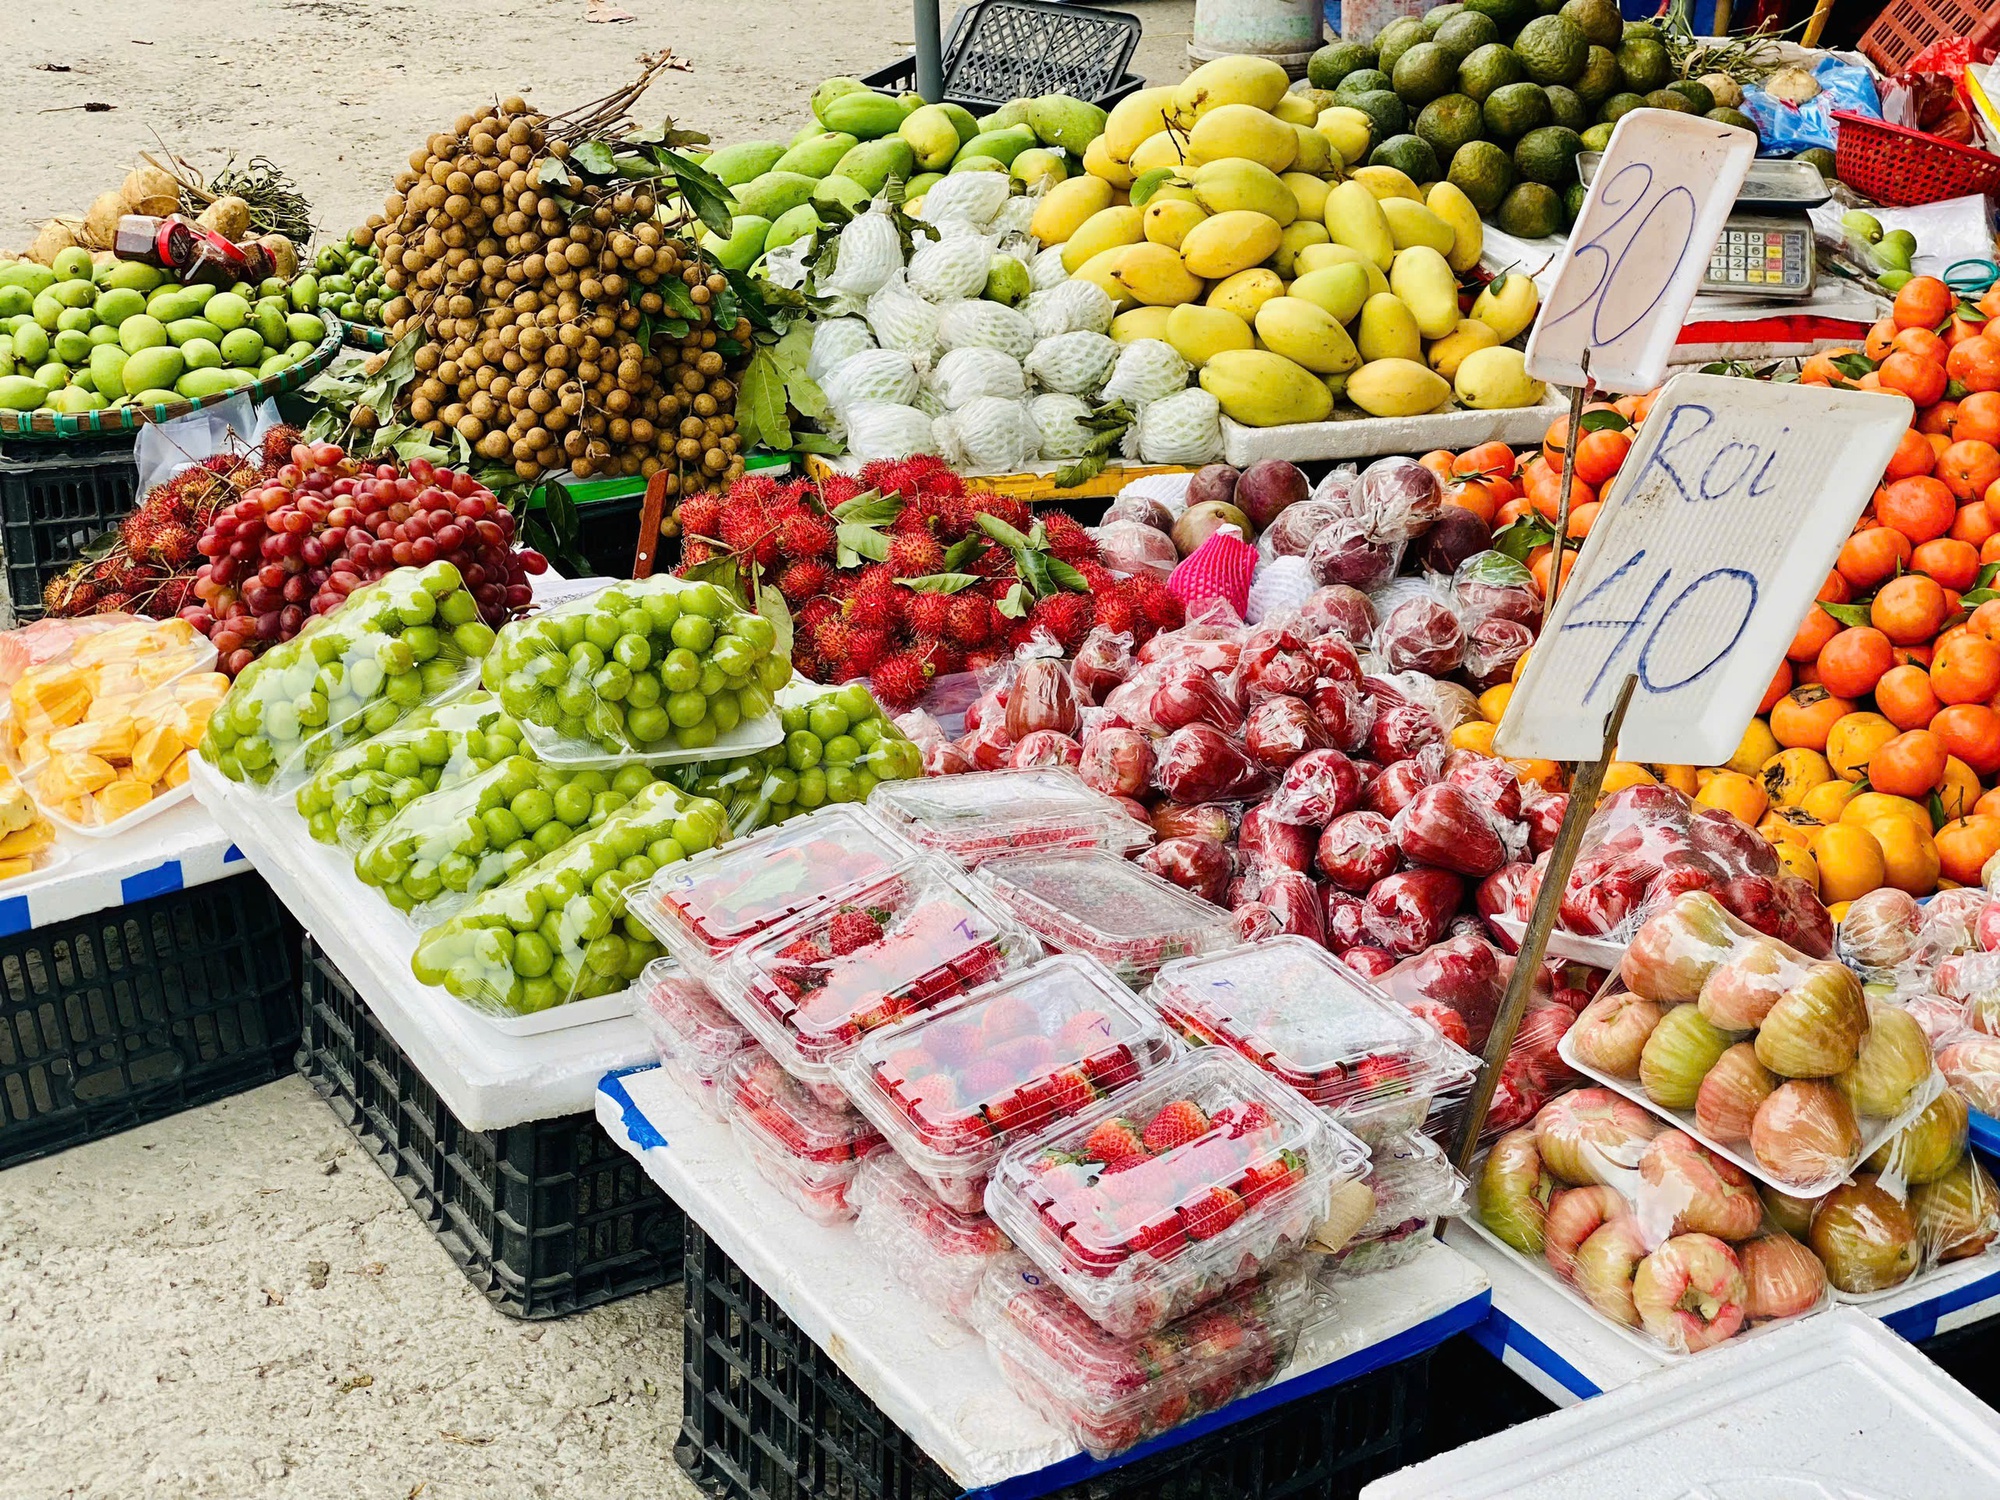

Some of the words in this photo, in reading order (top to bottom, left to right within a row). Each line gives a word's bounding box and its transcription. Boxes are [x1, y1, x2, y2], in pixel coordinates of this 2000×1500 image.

[1541, 162, 1697, 348] 30
[1715, 245, 1722, 254] 4
[1733, 246, 1742, 255] 5
[1751, 246, 1760, 256] 6
[1733, 233, 1742, 242] 8
[1752, 234, 1761, 243] 9
[1733, 258, 1742, 267] 2
[1751, 259, 1760, 268] 3
[1621, 403, 1791, 506] Roi
[1560, 548, 1759, 707] 40
